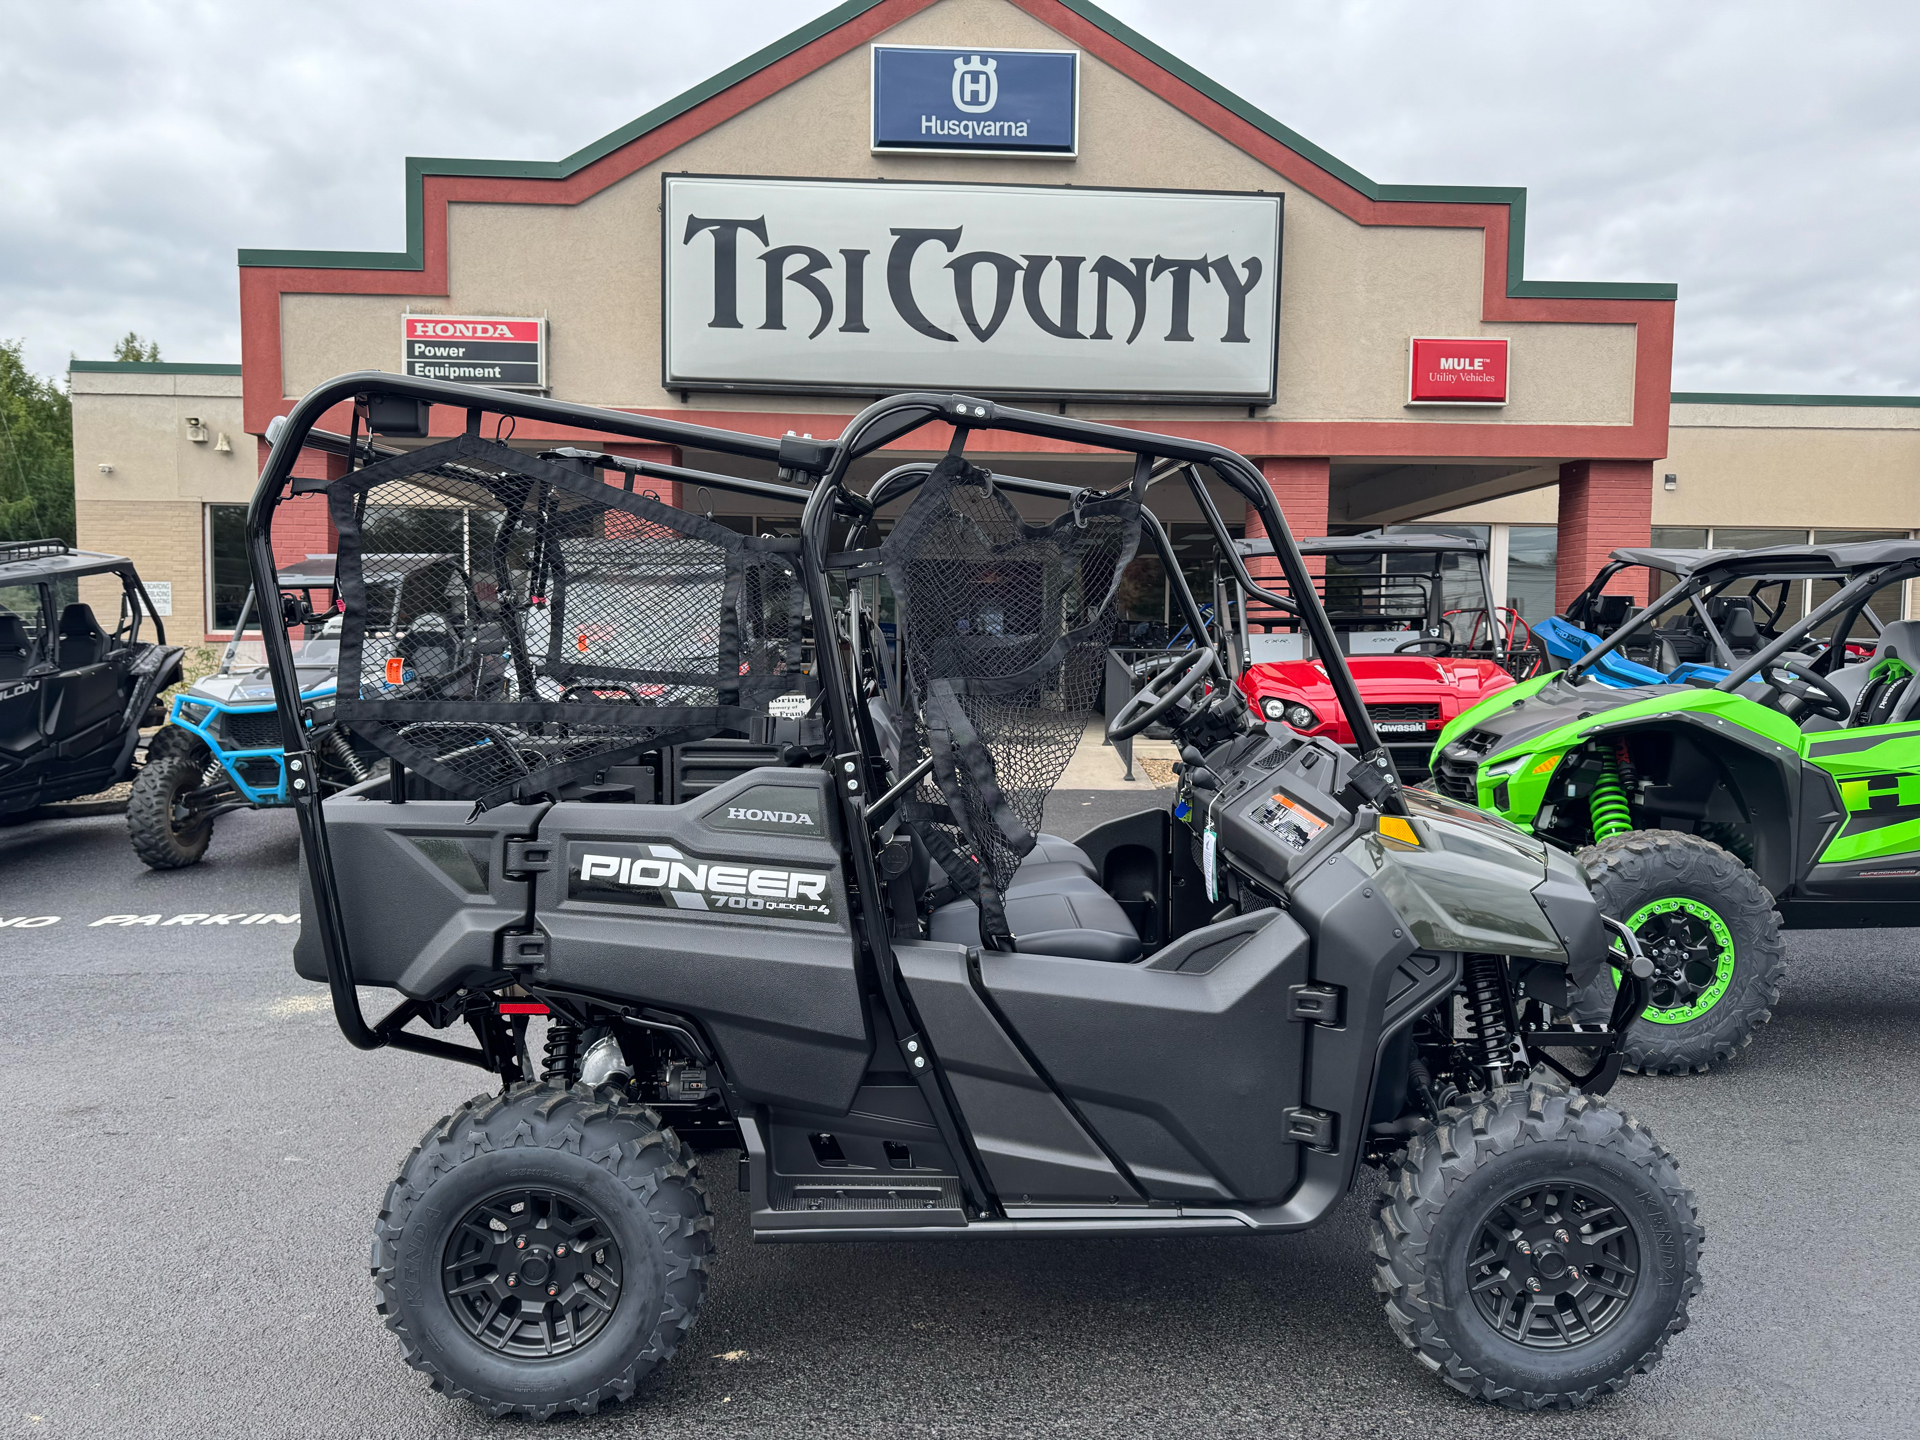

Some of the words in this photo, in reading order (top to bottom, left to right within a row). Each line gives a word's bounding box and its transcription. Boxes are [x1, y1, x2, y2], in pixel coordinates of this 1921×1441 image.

[921, 115, 1028, 139] Husqvarna
[414, 322, 514, 338] HONDA
[414, 343, 466, 357] Power
[414, 363, 501, 379] Equipment
[1429, 372, 1457, 384] Utility
[1460, 373, 1495, 382] Vehicles
[1373, 722, 1426, 732] Kawasaki
[727, 807, 815, 825] HONDA
[580, 854, 827, 900] PIONEER
[710, 894, 765, 910] 700
[87, 912, 302, 927] PARKIN
